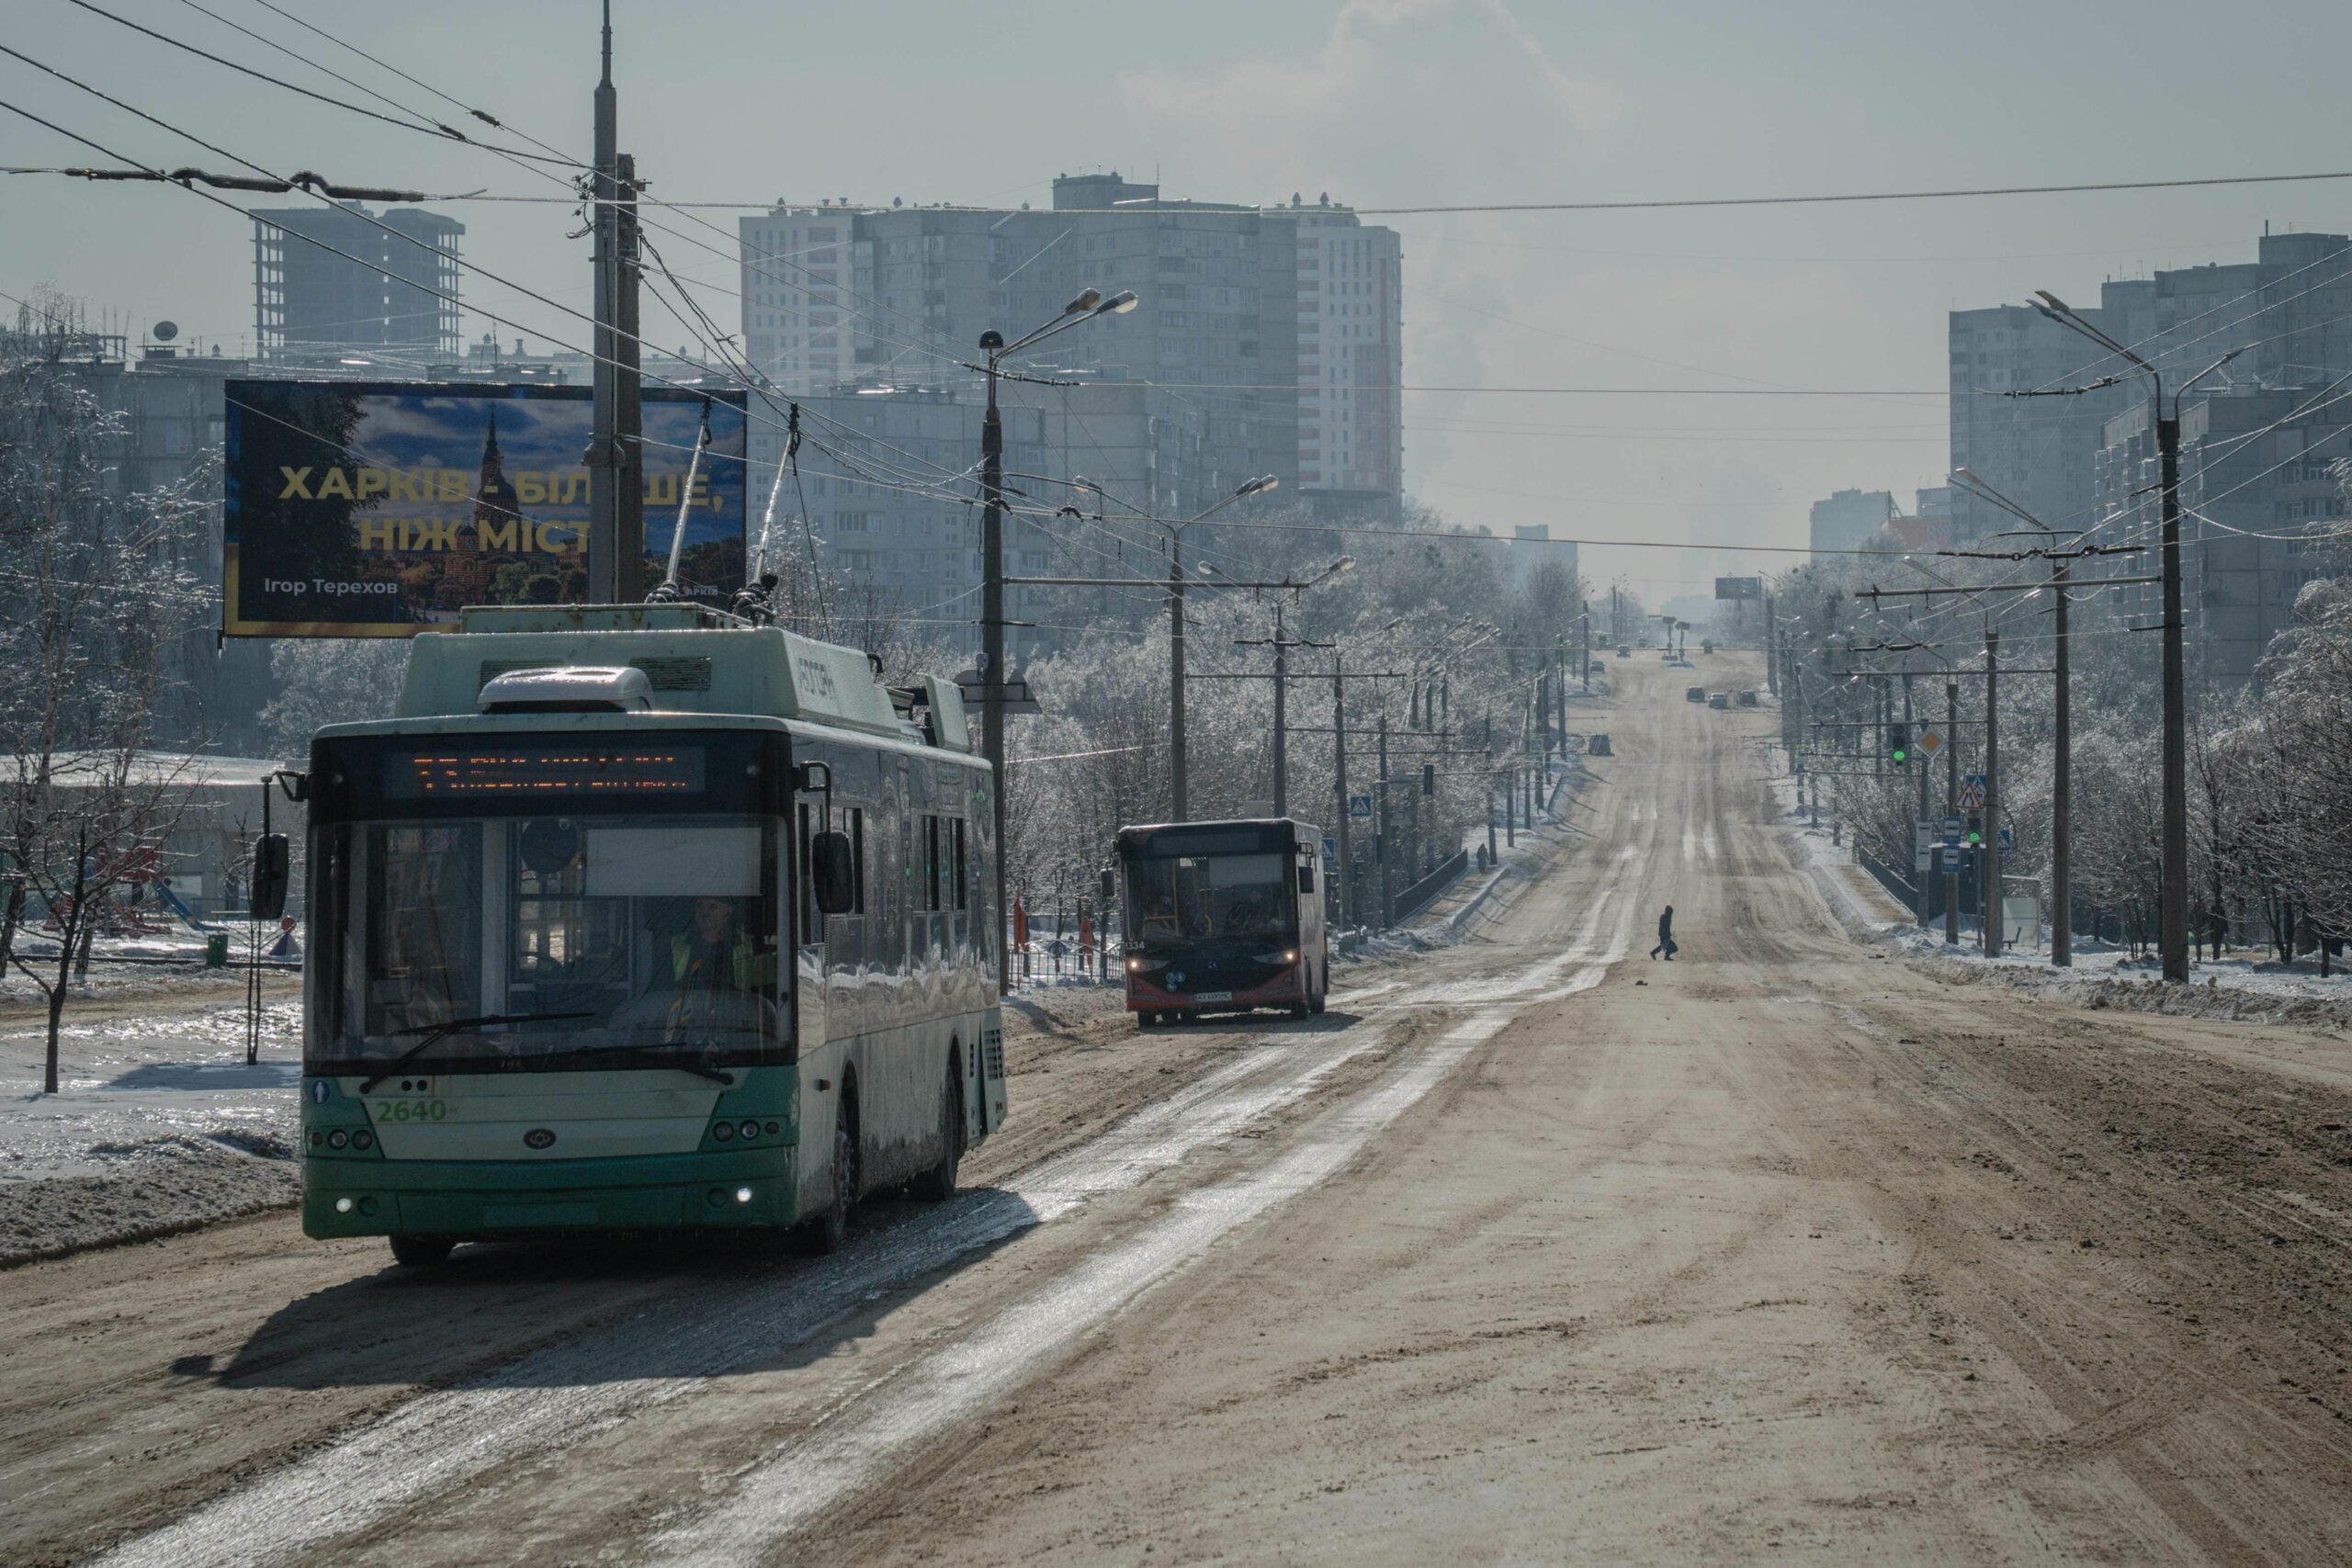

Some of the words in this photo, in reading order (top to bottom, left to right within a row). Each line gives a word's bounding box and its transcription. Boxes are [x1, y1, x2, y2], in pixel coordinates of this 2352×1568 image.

[278, 467, 470, 502] ХАРКІВ
[515, 470, 724, 512] БІЛШЕ,
[360, 517, 458, 552] НІЖ
[265, 578, 306, 596] Ігор
[311, 579, 398, 597] Терехов
[378, 1100, 447, 1122] 2640
